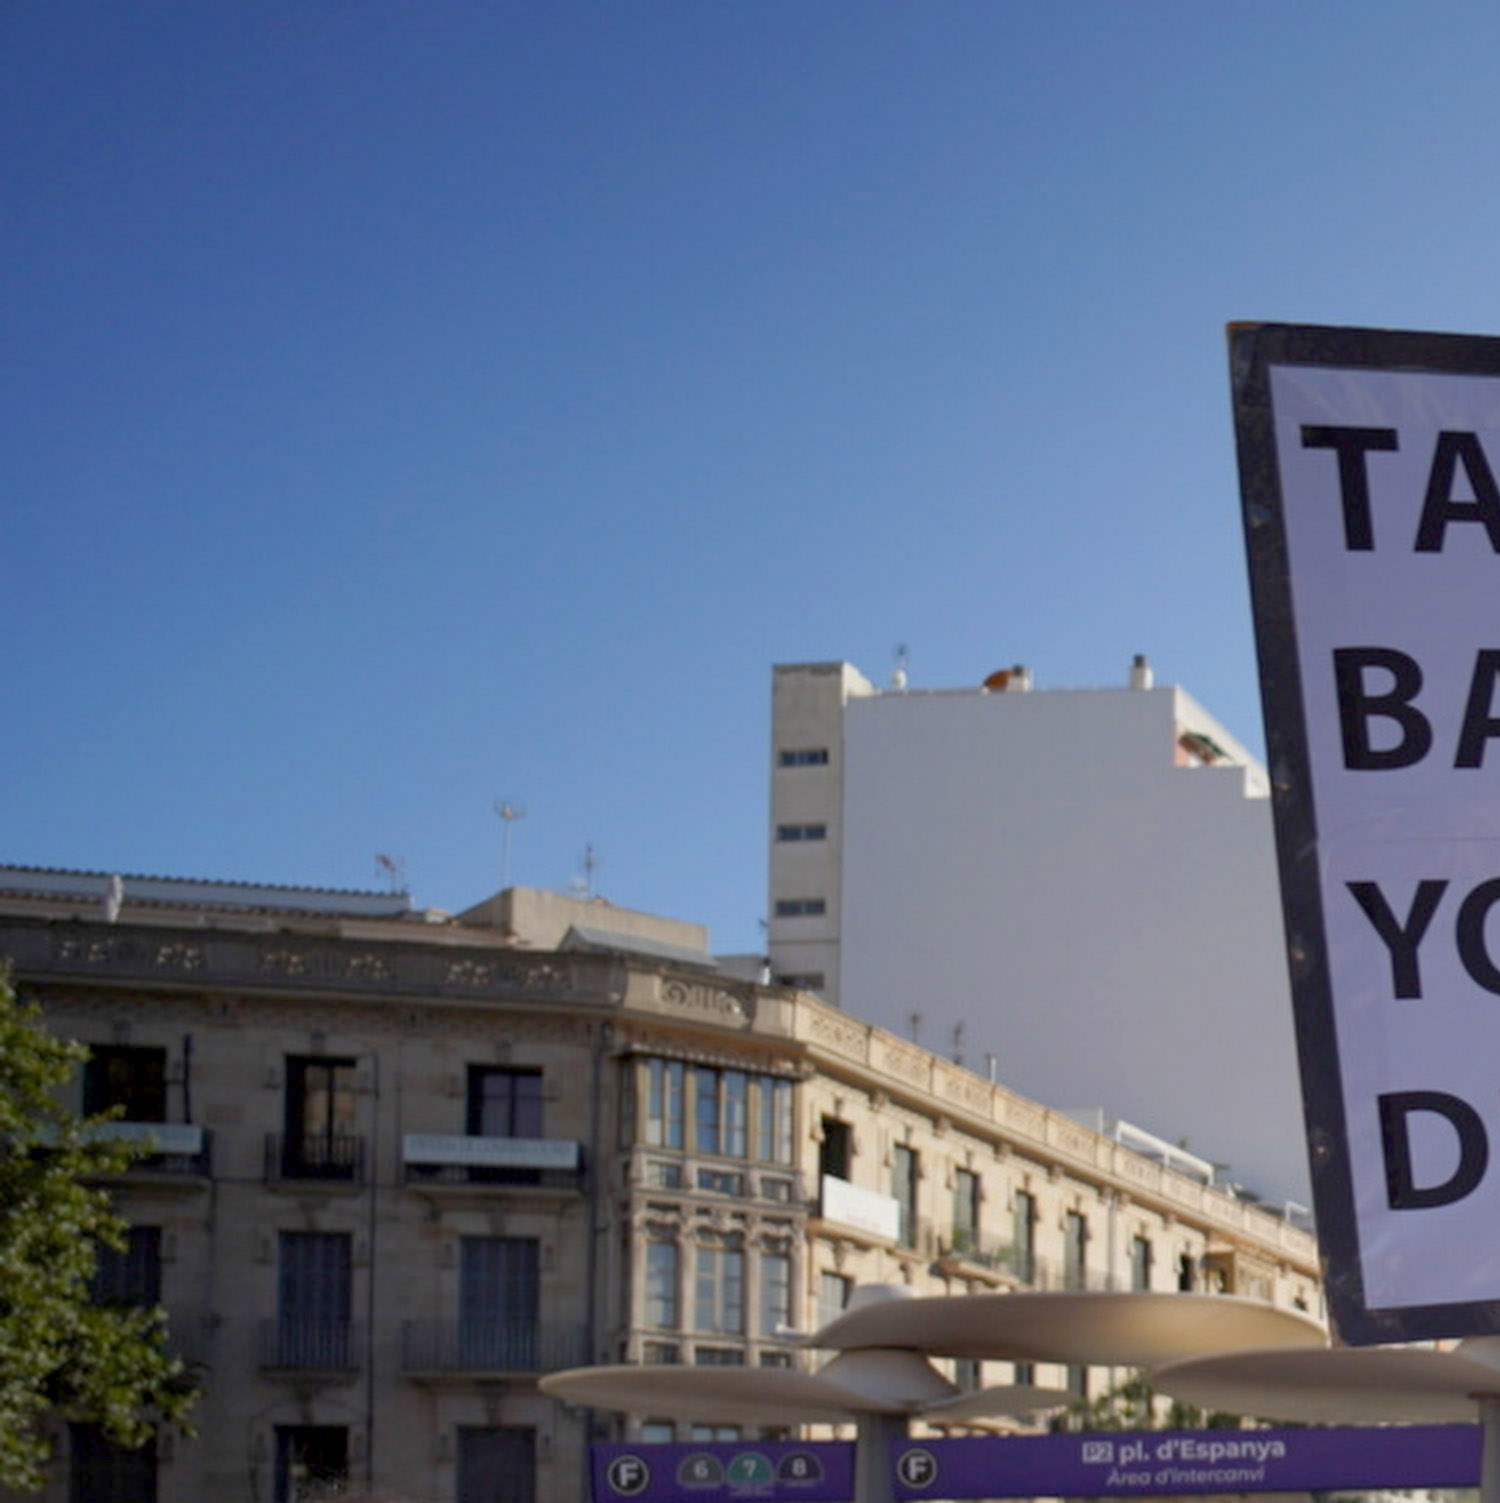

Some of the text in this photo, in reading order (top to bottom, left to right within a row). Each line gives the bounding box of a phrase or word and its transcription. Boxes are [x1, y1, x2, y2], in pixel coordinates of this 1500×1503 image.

[1119, 1440, 1149, 1465] pl.
[1156, 1438, 1286, 1462] d'Espanya
[619, 1462, 640, 1487] F
[693, 1457, 807, 1480] 6 7 8
[908, 1457, 928, 1481] F
